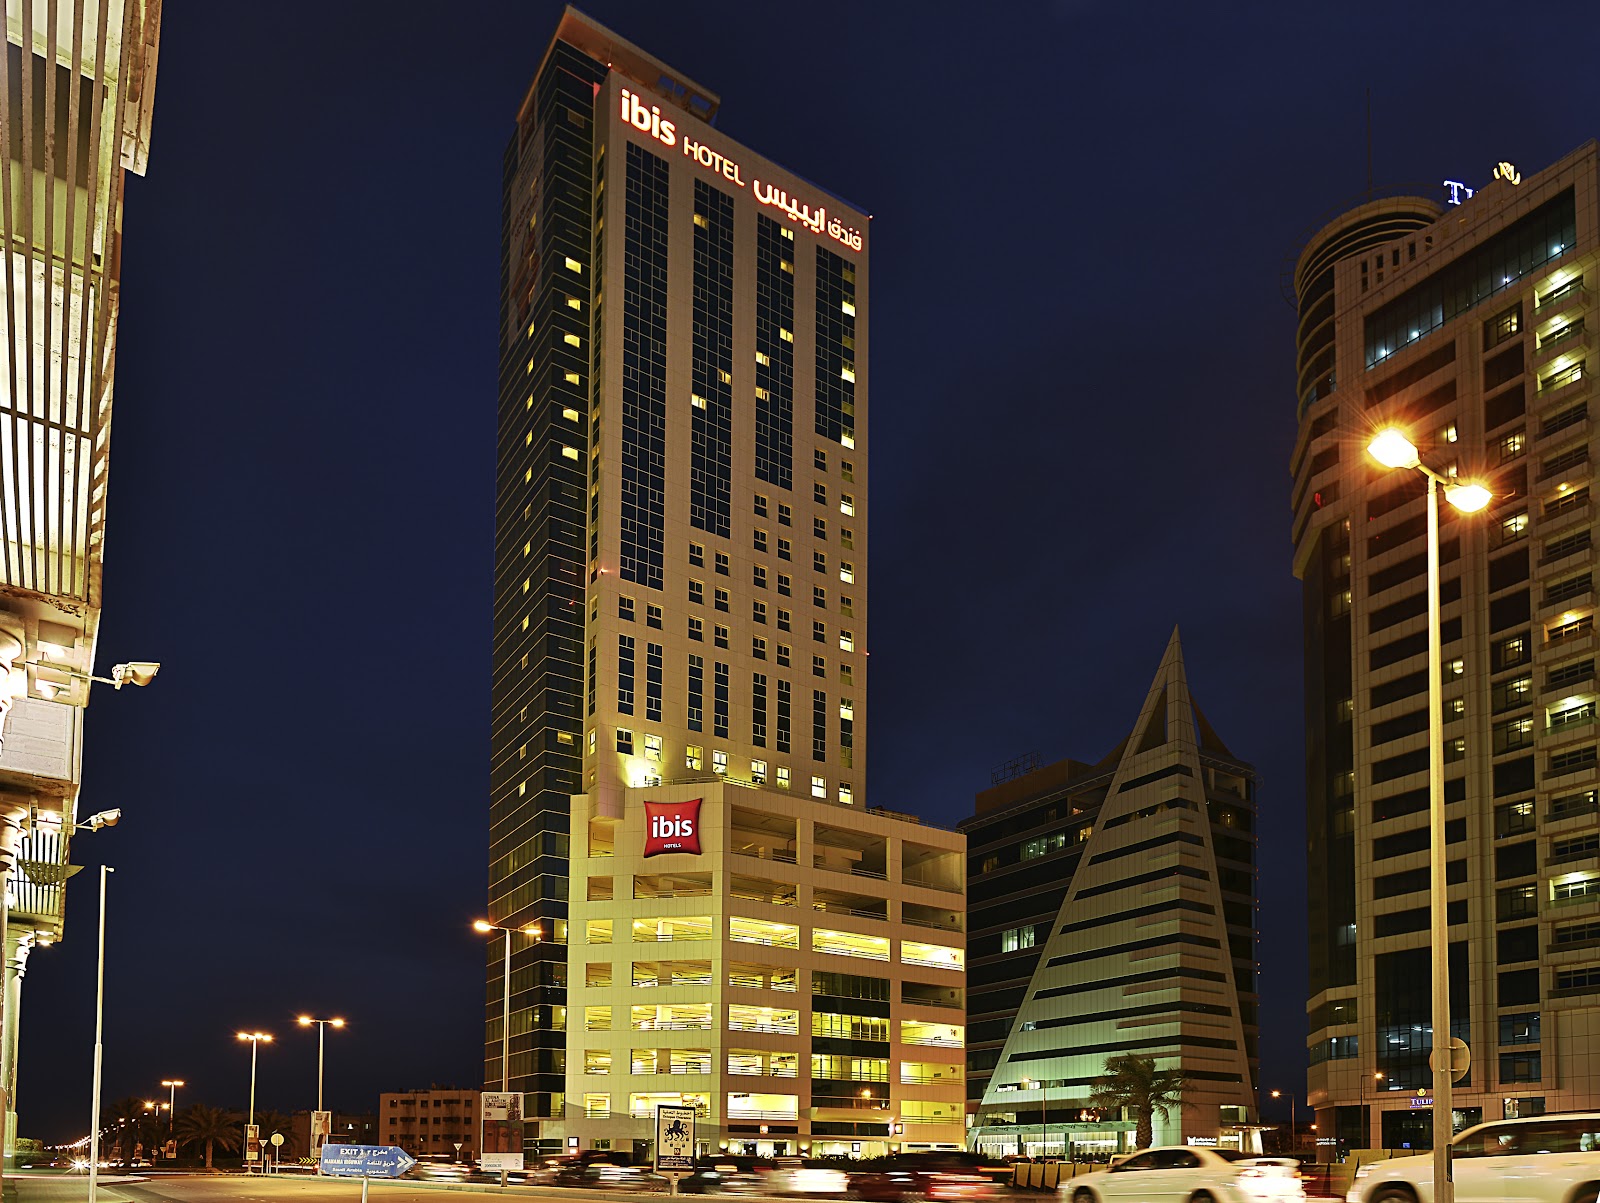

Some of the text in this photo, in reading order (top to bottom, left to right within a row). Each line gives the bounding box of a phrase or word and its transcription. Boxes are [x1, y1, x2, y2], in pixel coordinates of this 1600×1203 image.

[621, 88, 745, 187] ibis HOTEL
[827, 217, 862, 251] فندق
[652, 814, 693, 838] ibis
